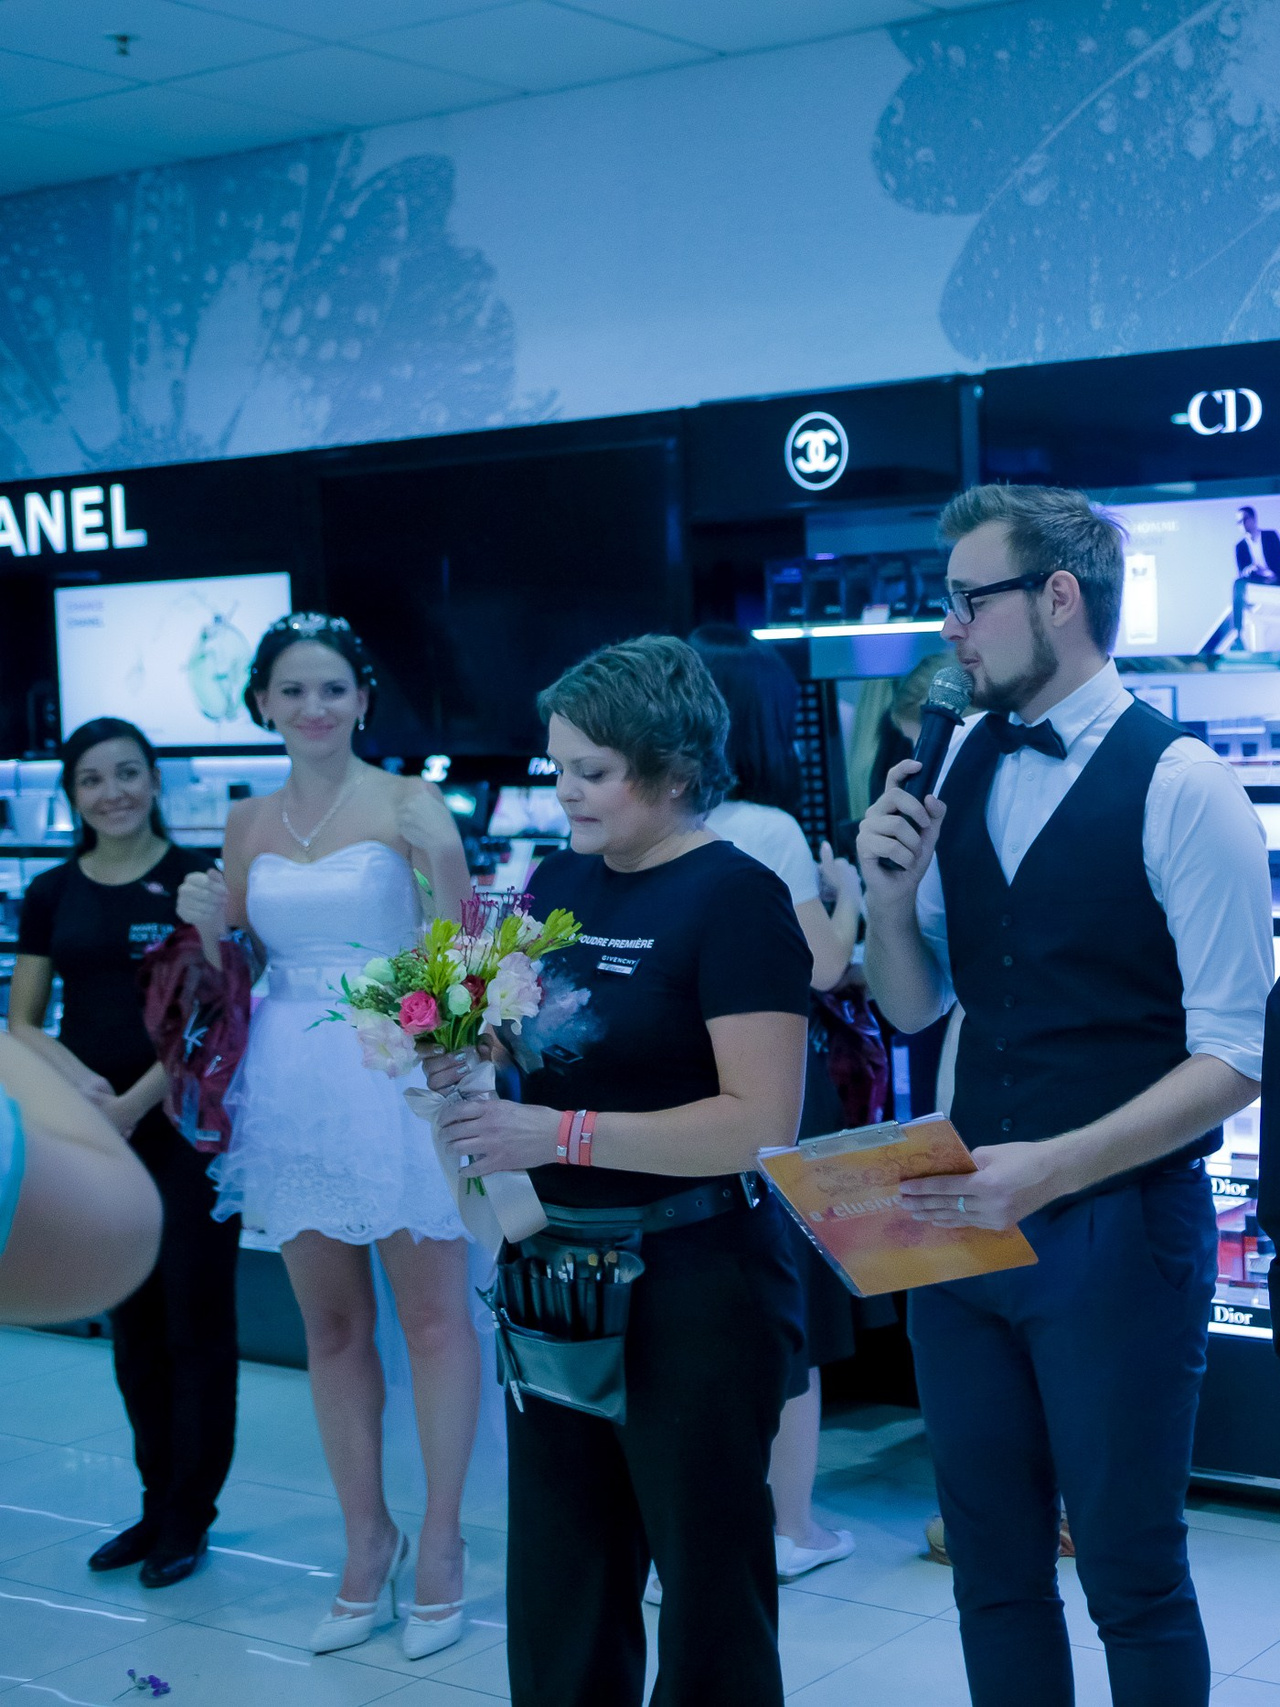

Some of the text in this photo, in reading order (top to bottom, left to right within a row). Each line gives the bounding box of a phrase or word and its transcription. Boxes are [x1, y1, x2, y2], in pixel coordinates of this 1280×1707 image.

[577, 934, 610, 947] OUDRE
[607, 937, 655, 949] PREMIÈRE
[601, 954, 637, 966] GIVENCHY
[1210, 1177, 1250, 1197] Dior
[1213, 1306, 1253, 1325] Dior
